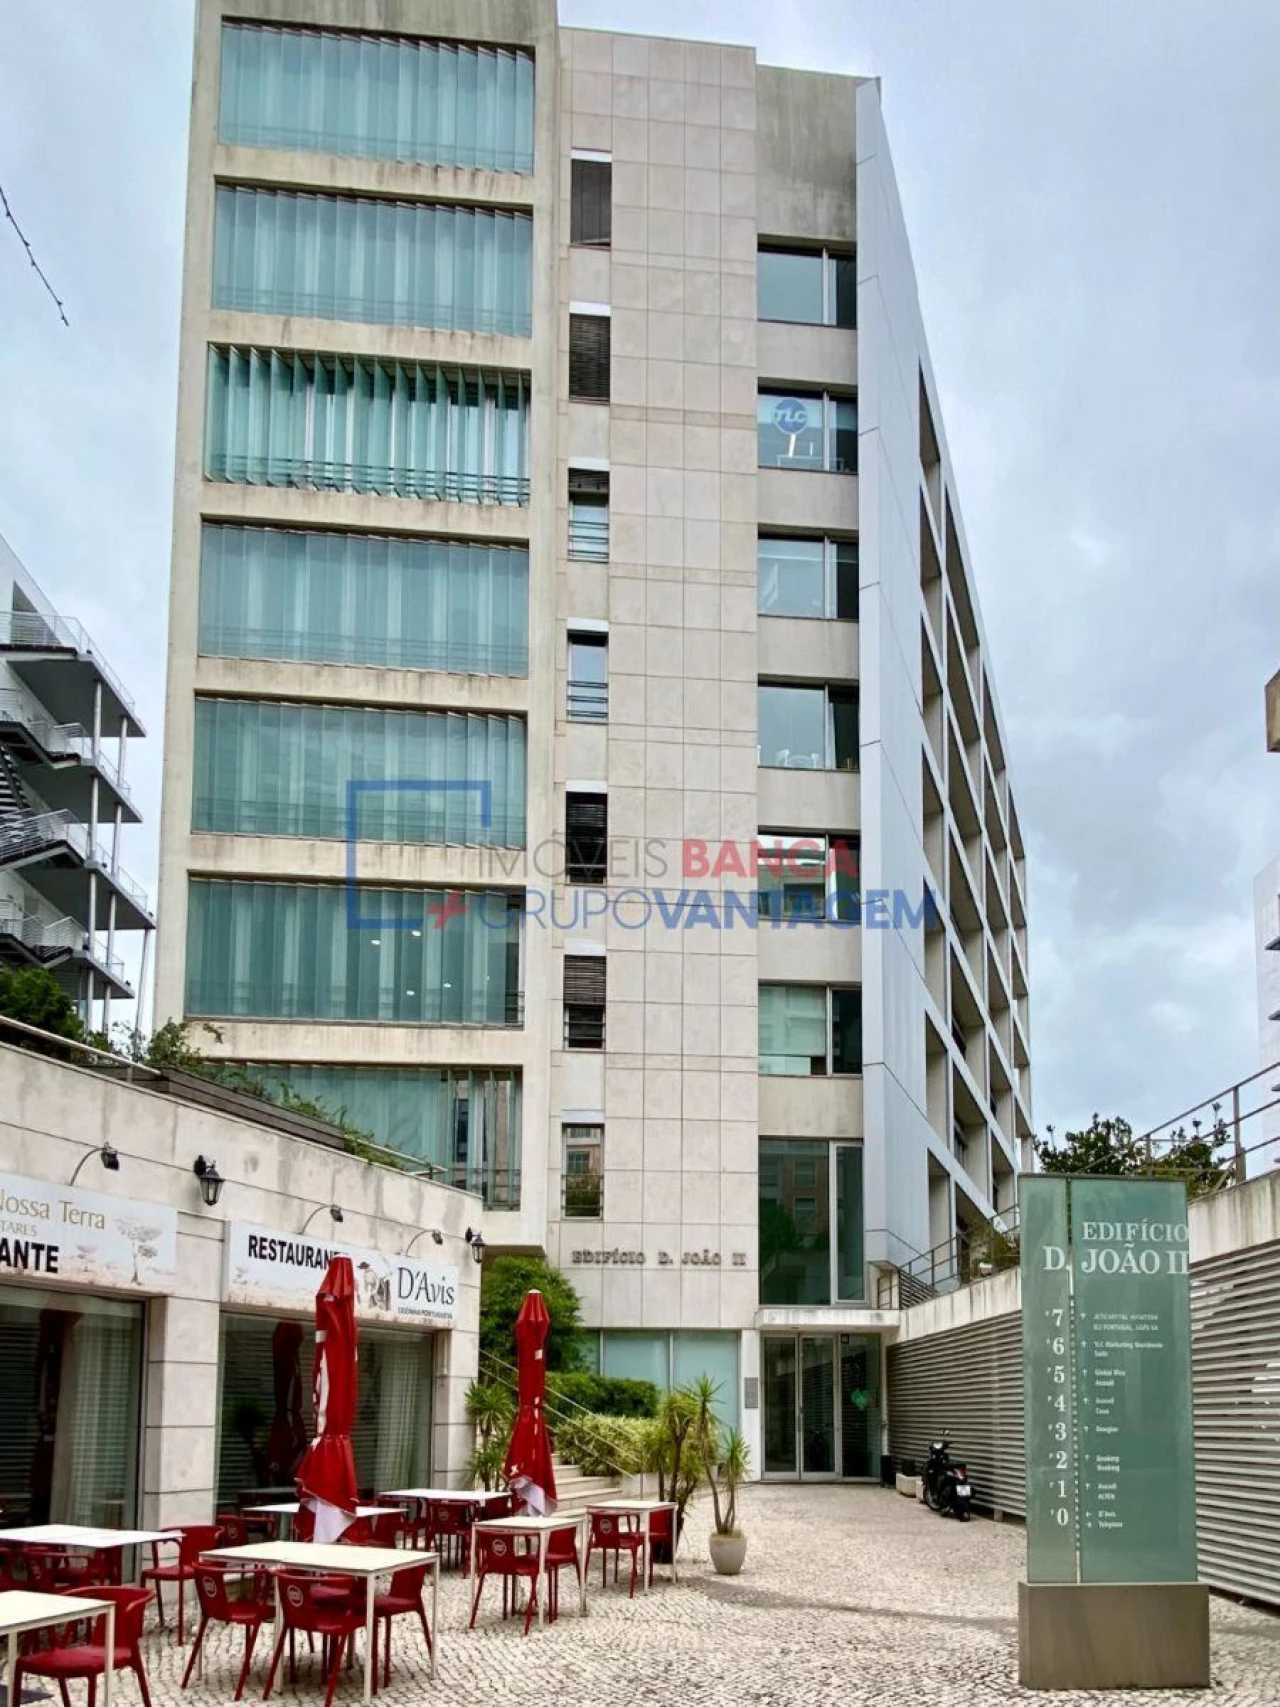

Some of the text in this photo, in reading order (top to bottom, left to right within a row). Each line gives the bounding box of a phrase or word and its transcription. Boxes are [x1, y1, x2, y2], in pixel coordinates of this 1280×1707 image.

[58, 1200, 105, 1230] Terra
[1082, 1217, 1189, 1243] EDIFÍCIO
[0, 1237, 60, 1274] ANTE
[248, 1234, 347, 1271] RESTAURAN
[658, 1251, 674, 1265] D.
[732, 1252, 746, 1266] II
[1081, 1243, 1160, 1275] JOÃO
[1166, 1250, 1190, 1275] II
[397, 1266, 455, 1306] D'Avis
